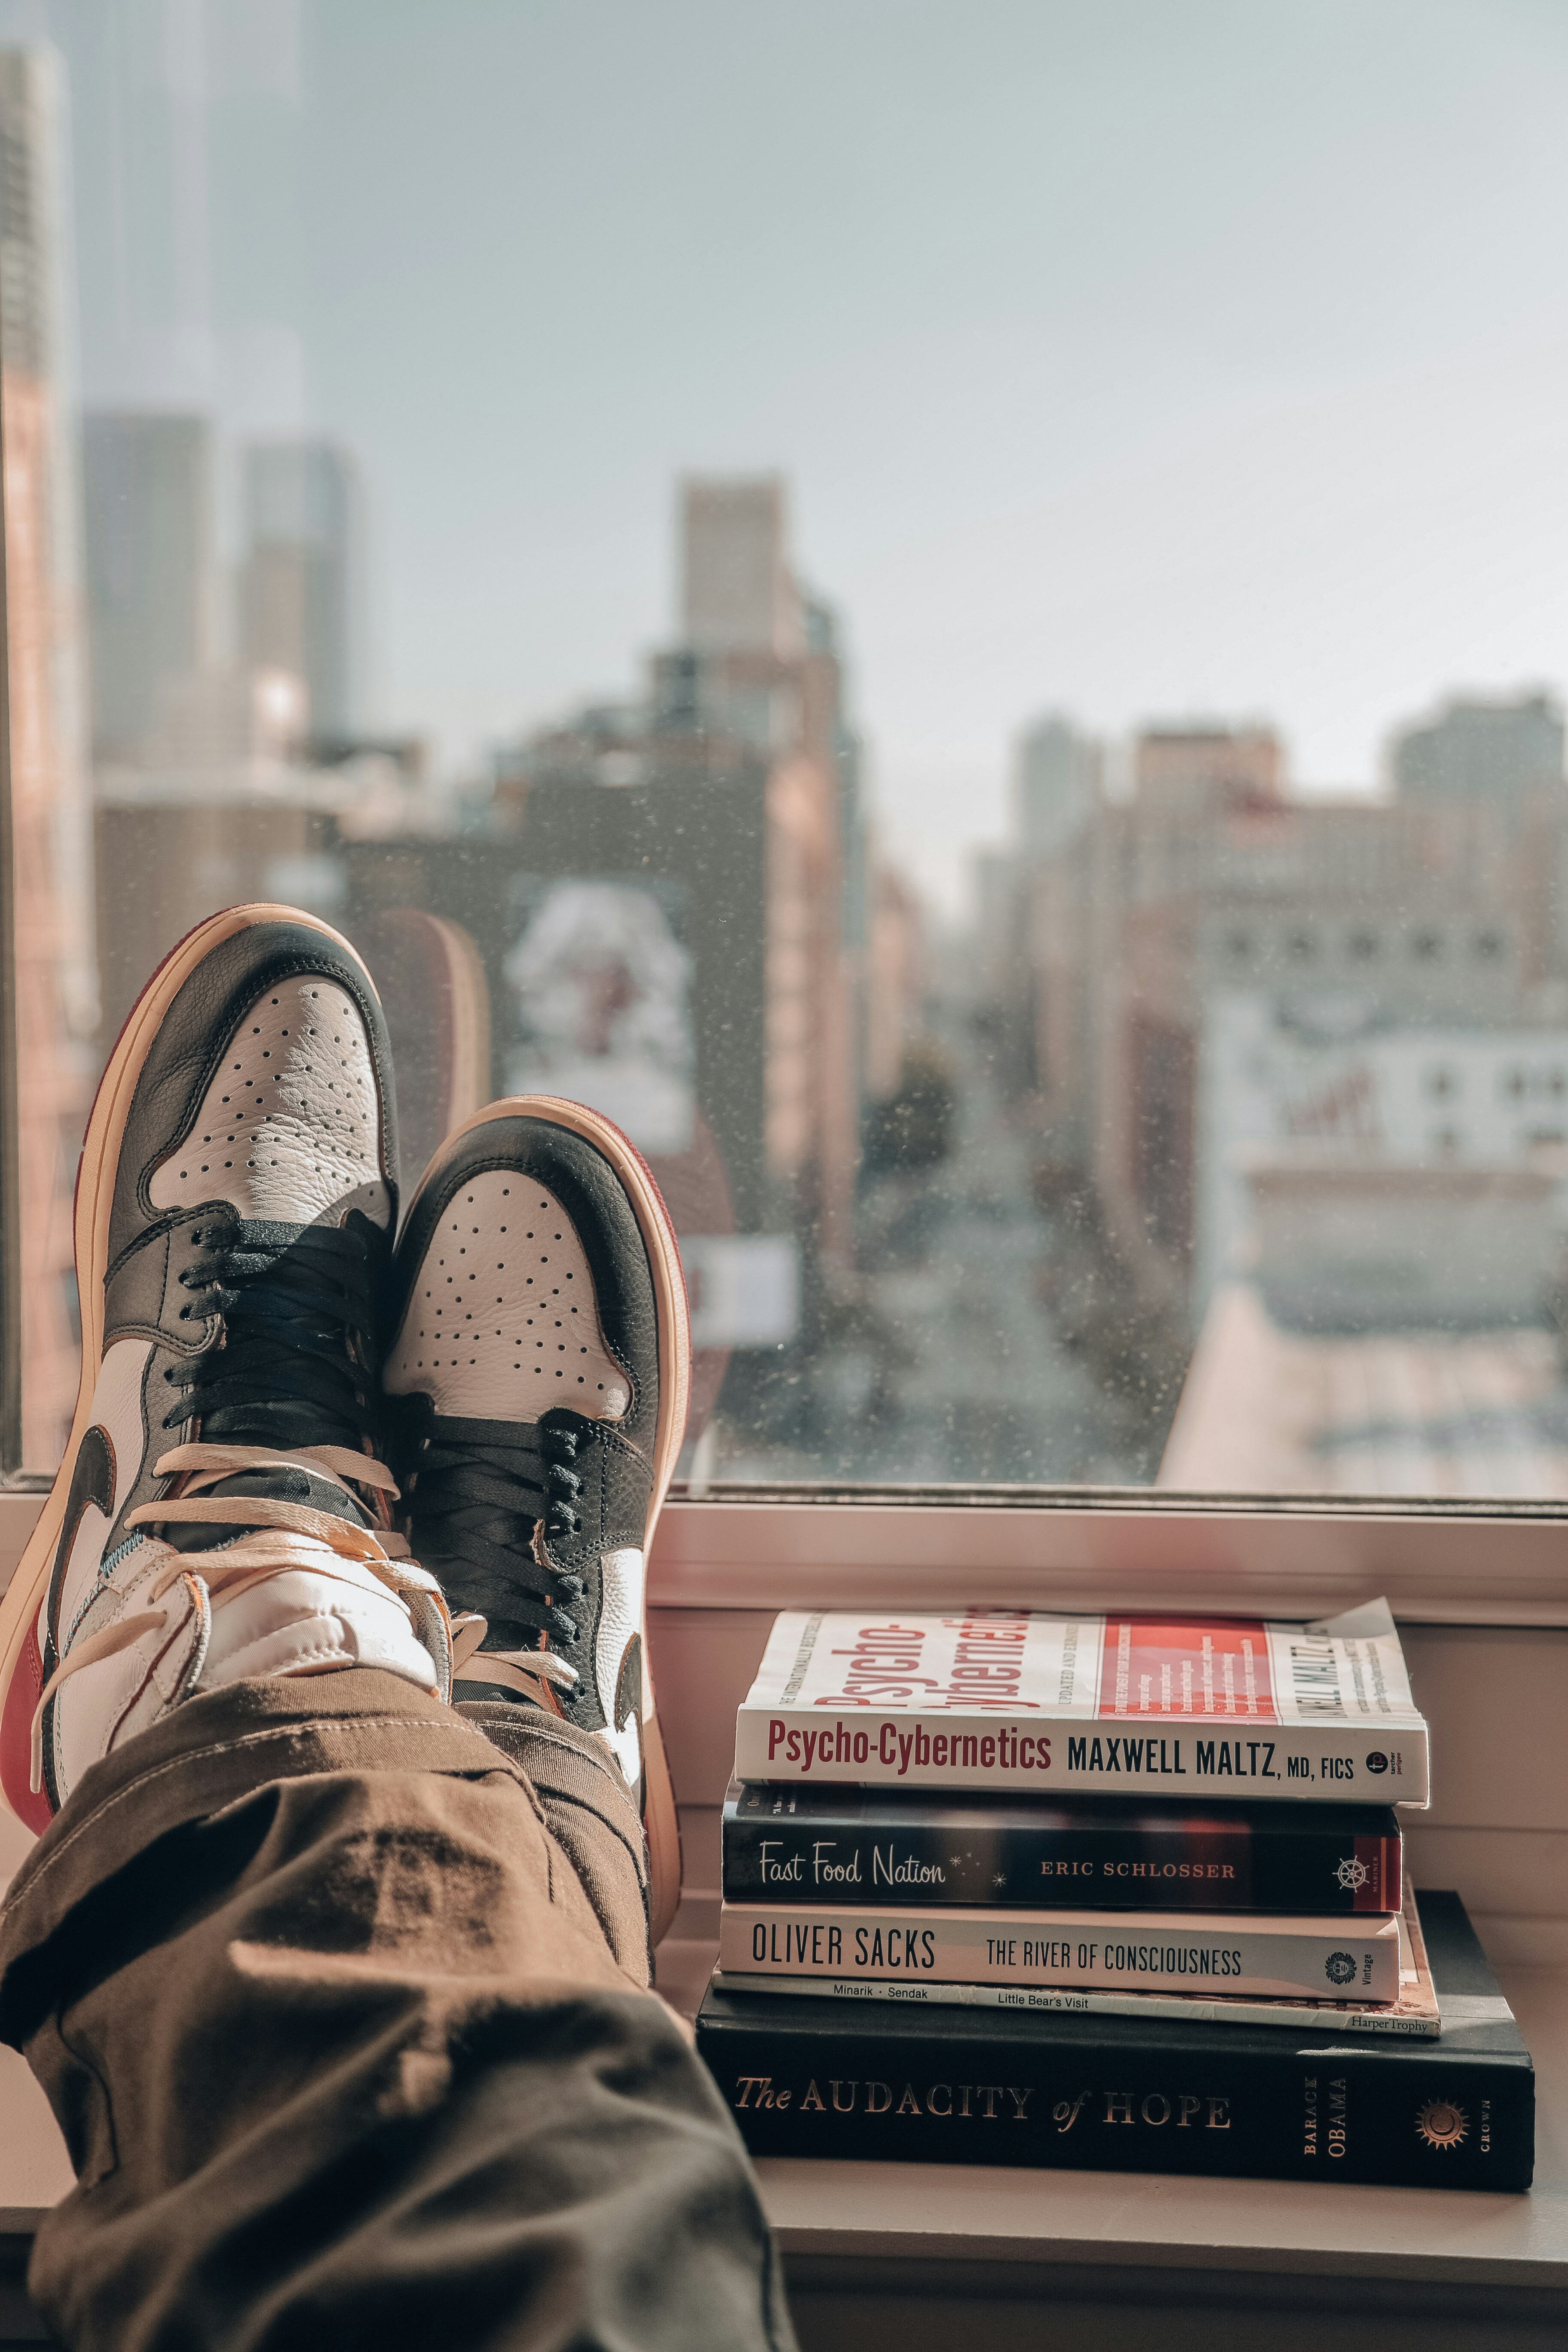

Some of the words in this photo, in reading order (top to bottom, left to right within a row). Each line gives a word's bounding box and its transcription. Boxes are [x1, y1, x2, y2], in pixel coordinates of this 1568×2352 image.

[783, 1649, 812, 1697] INTERNATIONALLY
[814, 1624, 938, 1707] Psycho-
[1062, 1652, 1076, 1669] AND
[1058, 1670, 1074, 1705] UPDATED
[768, 1719, 1052, 1776] Psycho-Cybernetics
[1069, 1737, 1186, 1773] MAXWELL
[1197, 1741, 1280, 1780] MALTZ,
[1288, 1757, 1314, 1781] MD,
[1322, 1758, 1354, 1779] FICS
[759, 1840, 806, 1883] Fast
[812, 1841, 862, 1884] Food
[873, 1844, 946, 1886] Nation
[1040, 1861, 1093, 1876] ERIC
[1103, 1862, 1235, 1879] SCHLOSSER
[753, 1923, 842, 1965] OLIVER
[855, 1927, 935, 1969] SACKS
[986, 1939, 1017, 1966] THE
[1023, 1941, 1070, 1968] RIVER
[1078, 1943, 1098, 1969] OF
[1105, 1945, 1241, 1976] CONSCIOUSNESS
[1362, 1954, 1374, 1985] Vintage
[833, 1984, 873, 1996] Minarik
[887, 1987, 928, 2000] Sendak
[998, 1993, 1025, 2005] Little
[1028, 1994, 1062, 2008] Bear's
[1064, 1997, 1089, 2009] Visit
[735, 2076, 791, 2110] The
[799, 2079, 1035, 2120] AUDACITY
[1053, 2090, 1093, 2133] of
[1102, 2092, 1231, 2129] HOPE
[1304, 2076, 1317, 2155] BARACK
[1328, 2077, 1346, 2158] OBAMA
[1480, 2100, 1490, 2153] CROWN
